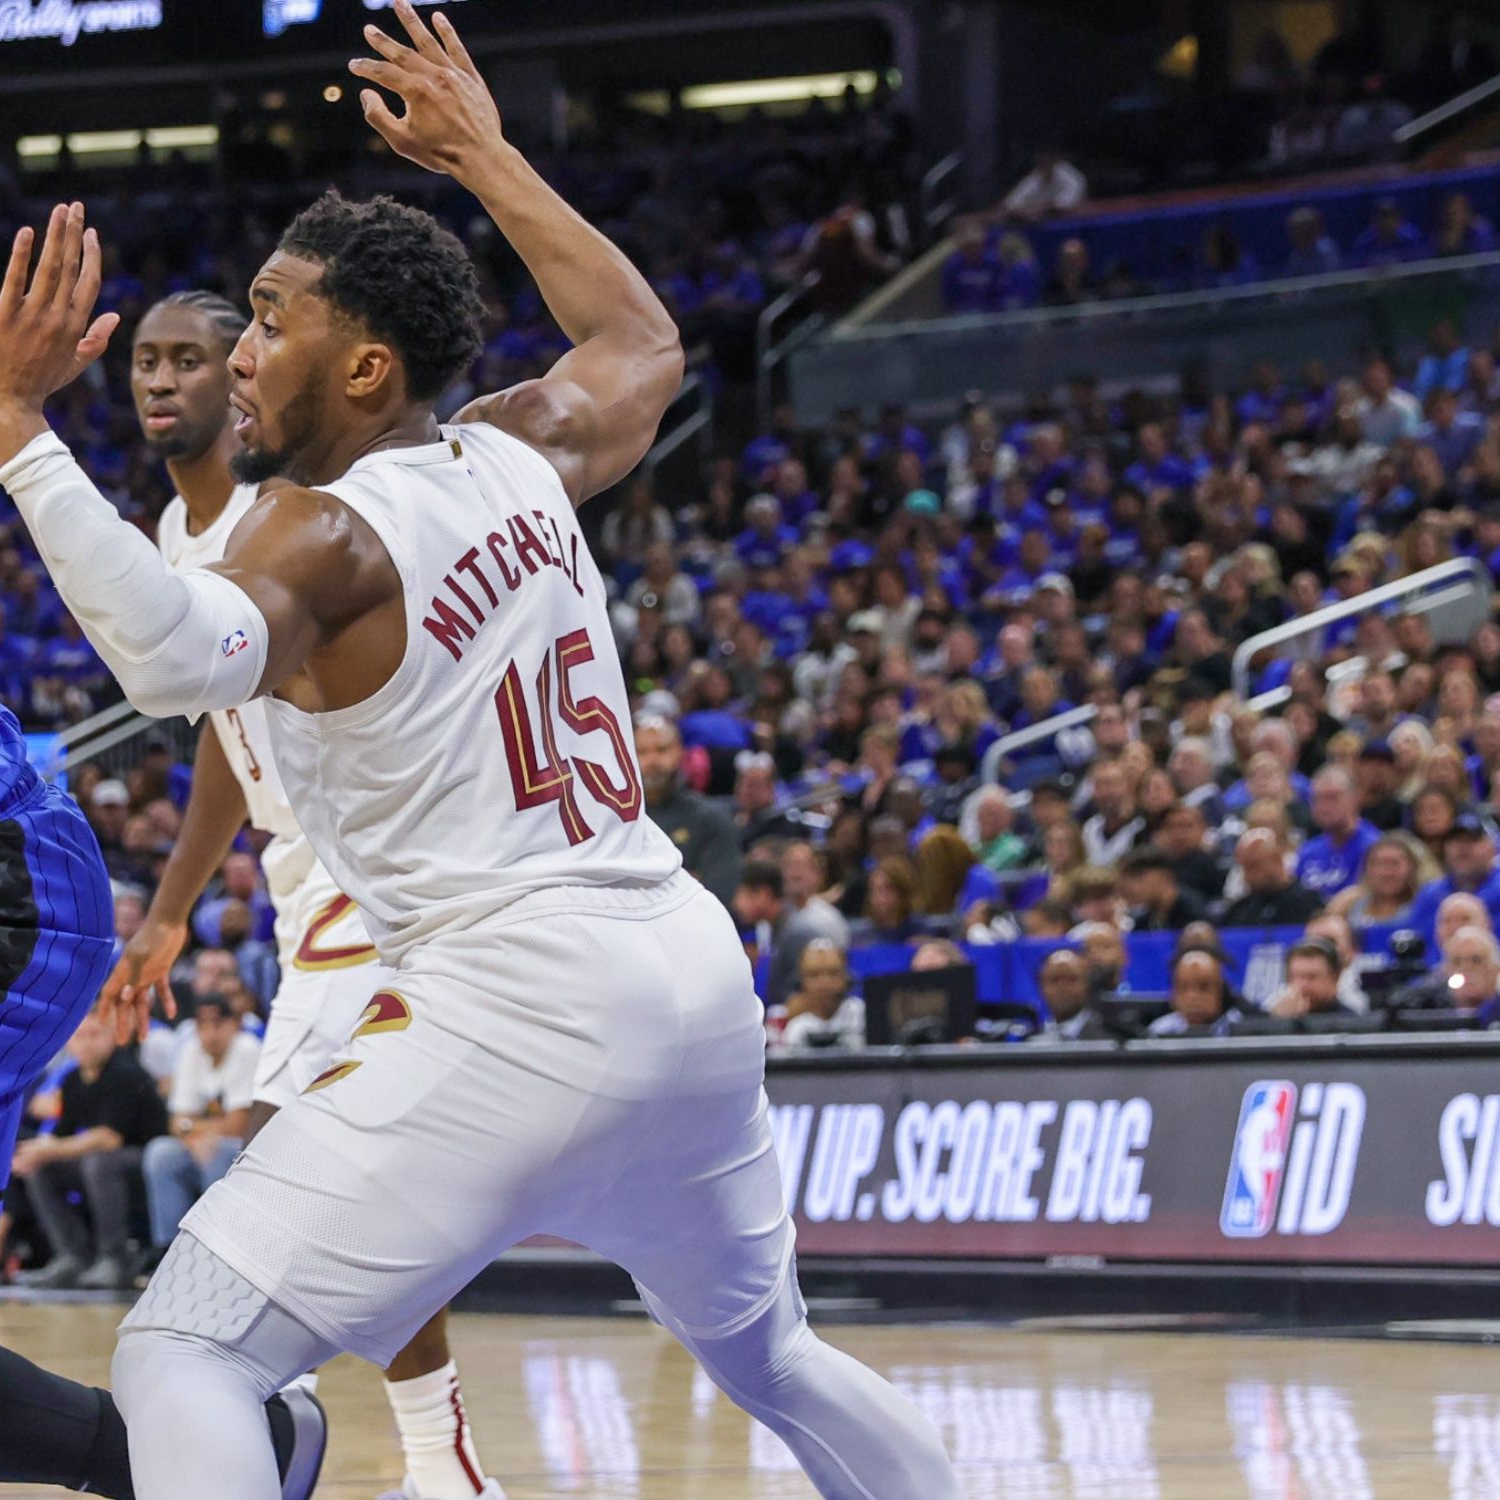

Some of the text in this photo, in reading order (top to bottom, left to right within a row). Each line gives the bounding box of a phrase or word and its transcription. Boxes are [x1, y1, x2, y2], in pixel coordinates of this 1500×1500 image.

[422, 510, 584, 662] MITCHELL
[494, 628, 641, 846] 45
[804, 1103, 885, 1222] UP.
[881, 1100, 1059, 1223] SCORE
[1045, 1098, 1153, 1223] BIG.
